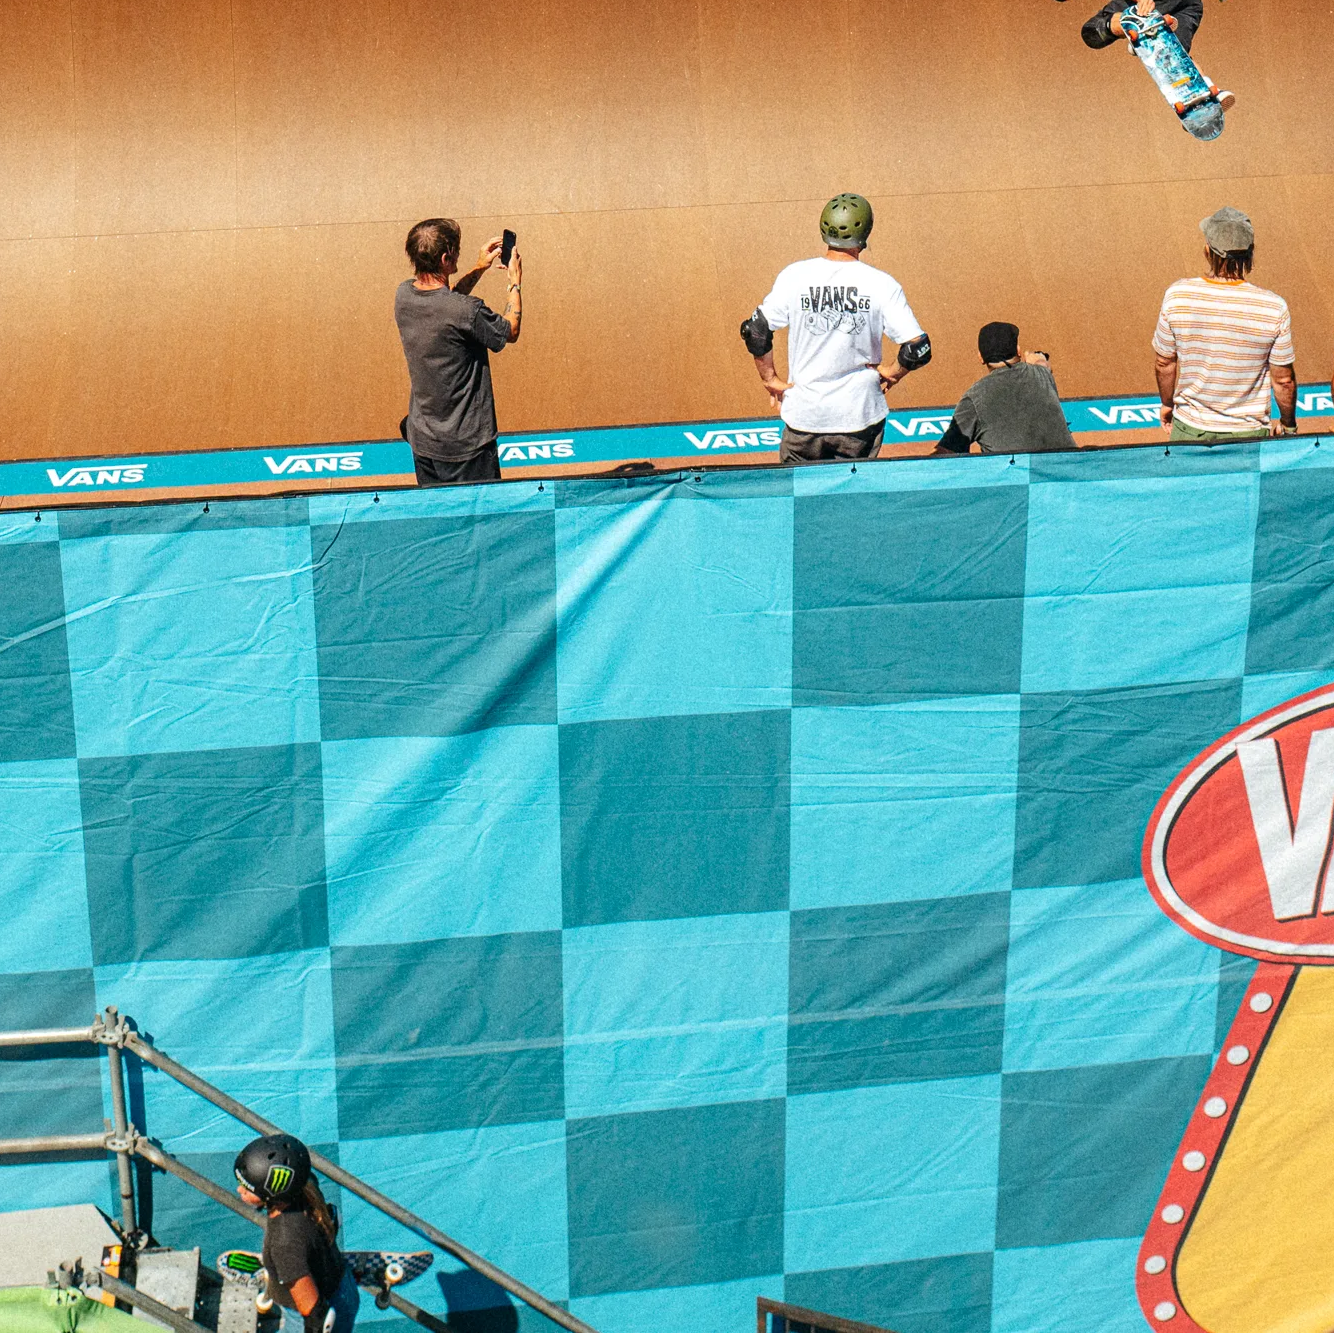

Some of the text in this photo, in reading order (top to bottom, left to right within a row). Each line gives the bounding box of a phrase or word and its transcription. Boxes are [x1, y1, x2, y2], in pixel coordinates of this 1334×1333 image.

[801, 286, 870, 313] 19 VANS 66
[47, 463, 147, 487] VANS
[264, 451, 363, 475] VANS
[684, 427, 781, 449] VANS
[1088, 403, 1163, 424] VAN
